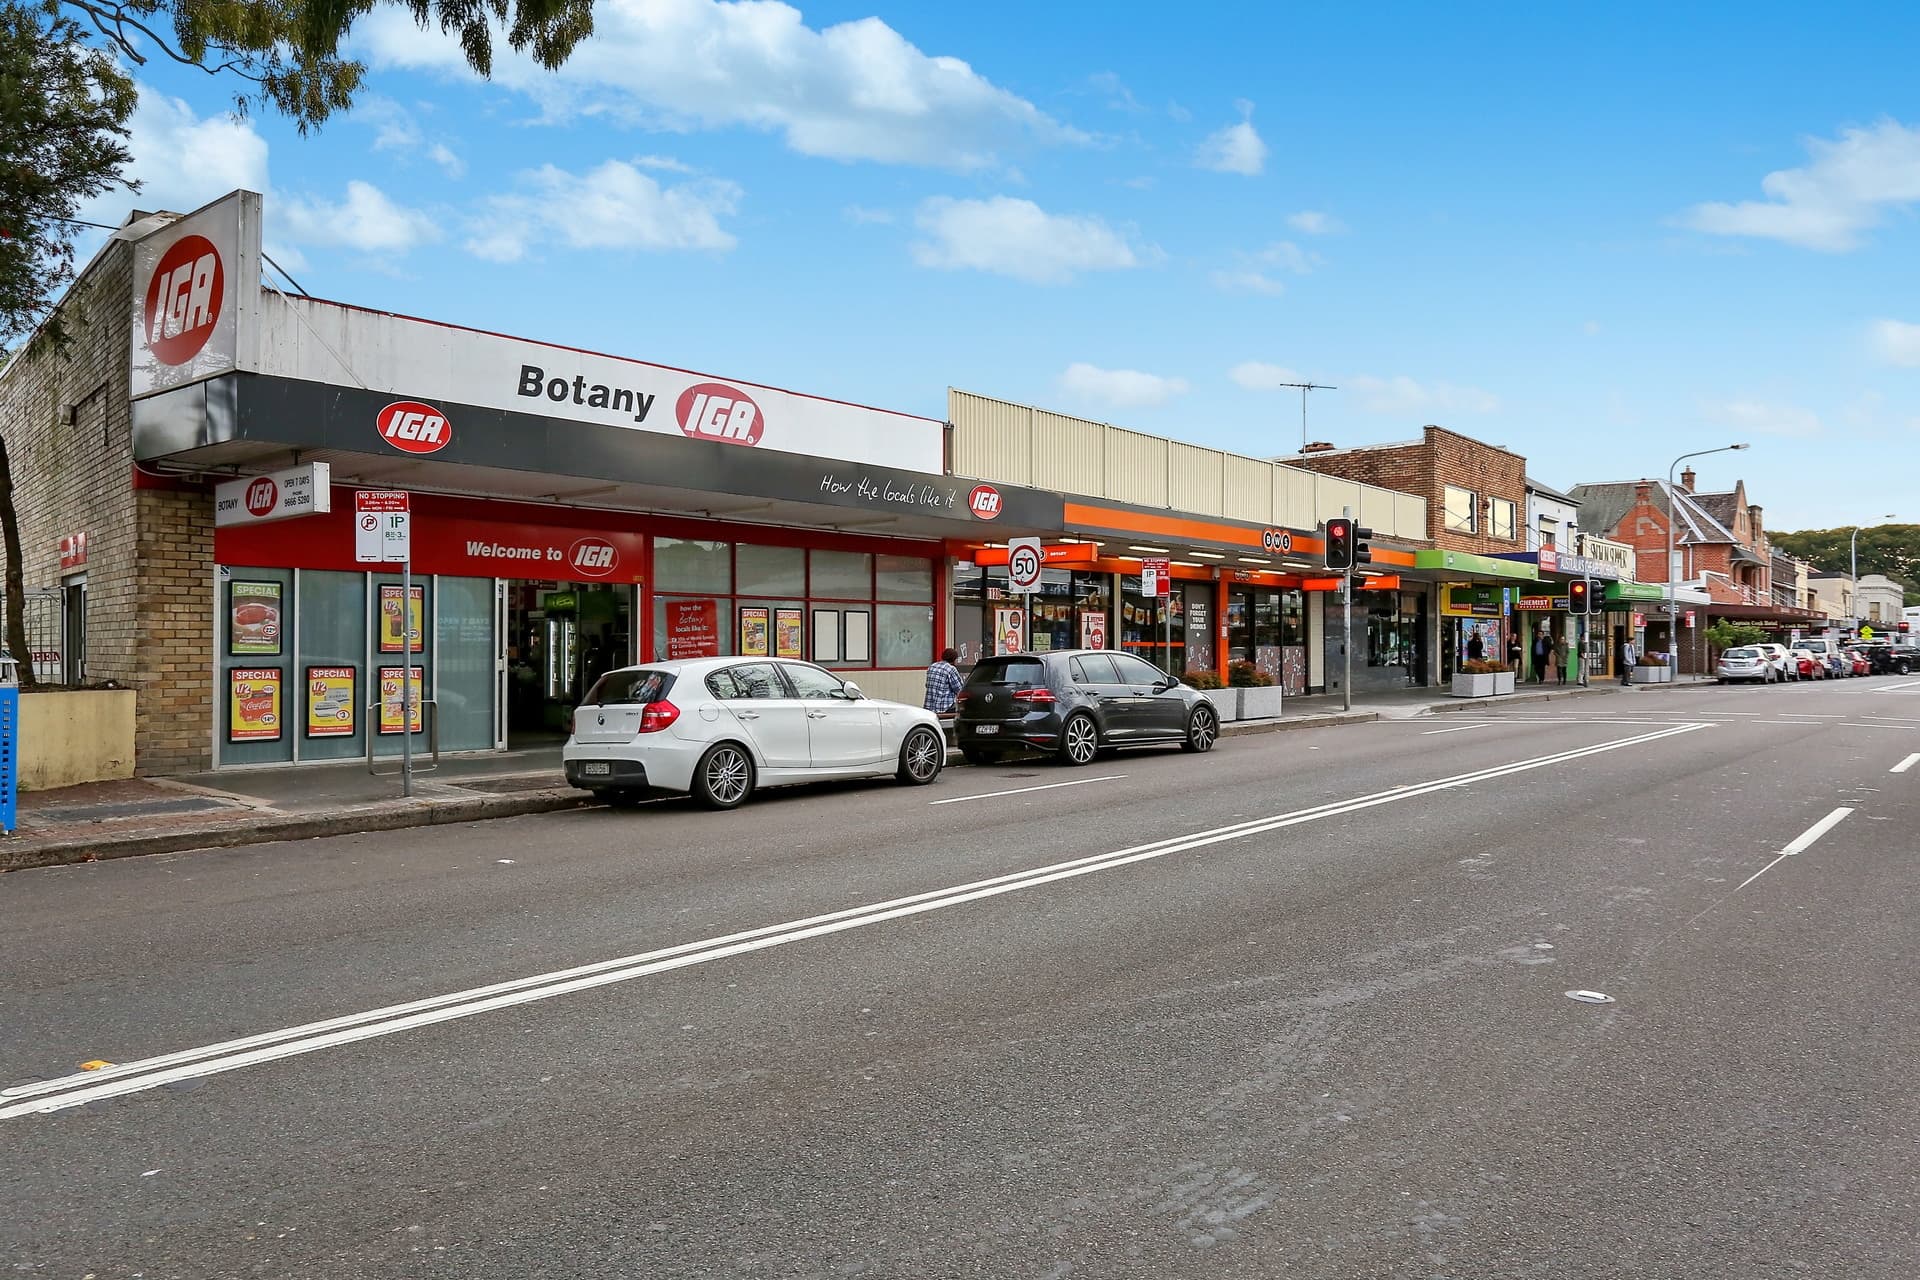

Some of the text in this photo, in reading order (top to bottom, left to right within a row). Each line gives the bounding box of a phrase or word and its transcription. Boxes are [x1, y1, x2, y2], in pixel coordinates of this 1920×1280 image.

[151, 252, 216, 343] IGA
[517, 364, 655, 423] Botany
[684, 393, 757, 441] IGA
[385, 410, 441, 443] IGA
[284, 479, 295, 488] OPEN
[299, 475, 310, 485] DAYS
[248, 482, 273, 510] IGA
[820, 475, 957, 508] How the locals like it
[218, 498, 238, 511] BOTANY
[972, 490, 999, 512] IGA
[390, 516, 405, 528] 1P
[466, 541, 563, 561] Welcome to
[574, 545, 613, 568] IGA
[1015, 557, 1035, 576] 50
[236, 585, 278, 596] SPECIAL
[384, 590, 421, 598] SPECAL
[743, 610, 766, 618] SPECIAL
[236, 671, 278, 680] SPECIAL
[312, 669, 351, 678] SPECIAL
[384, 671, 420, 679] SPECAL
[236, 683, 251, 694] 1/2
[312, 682, 326, 691] 1/2
[384, 682, 397, 691] 1/2
